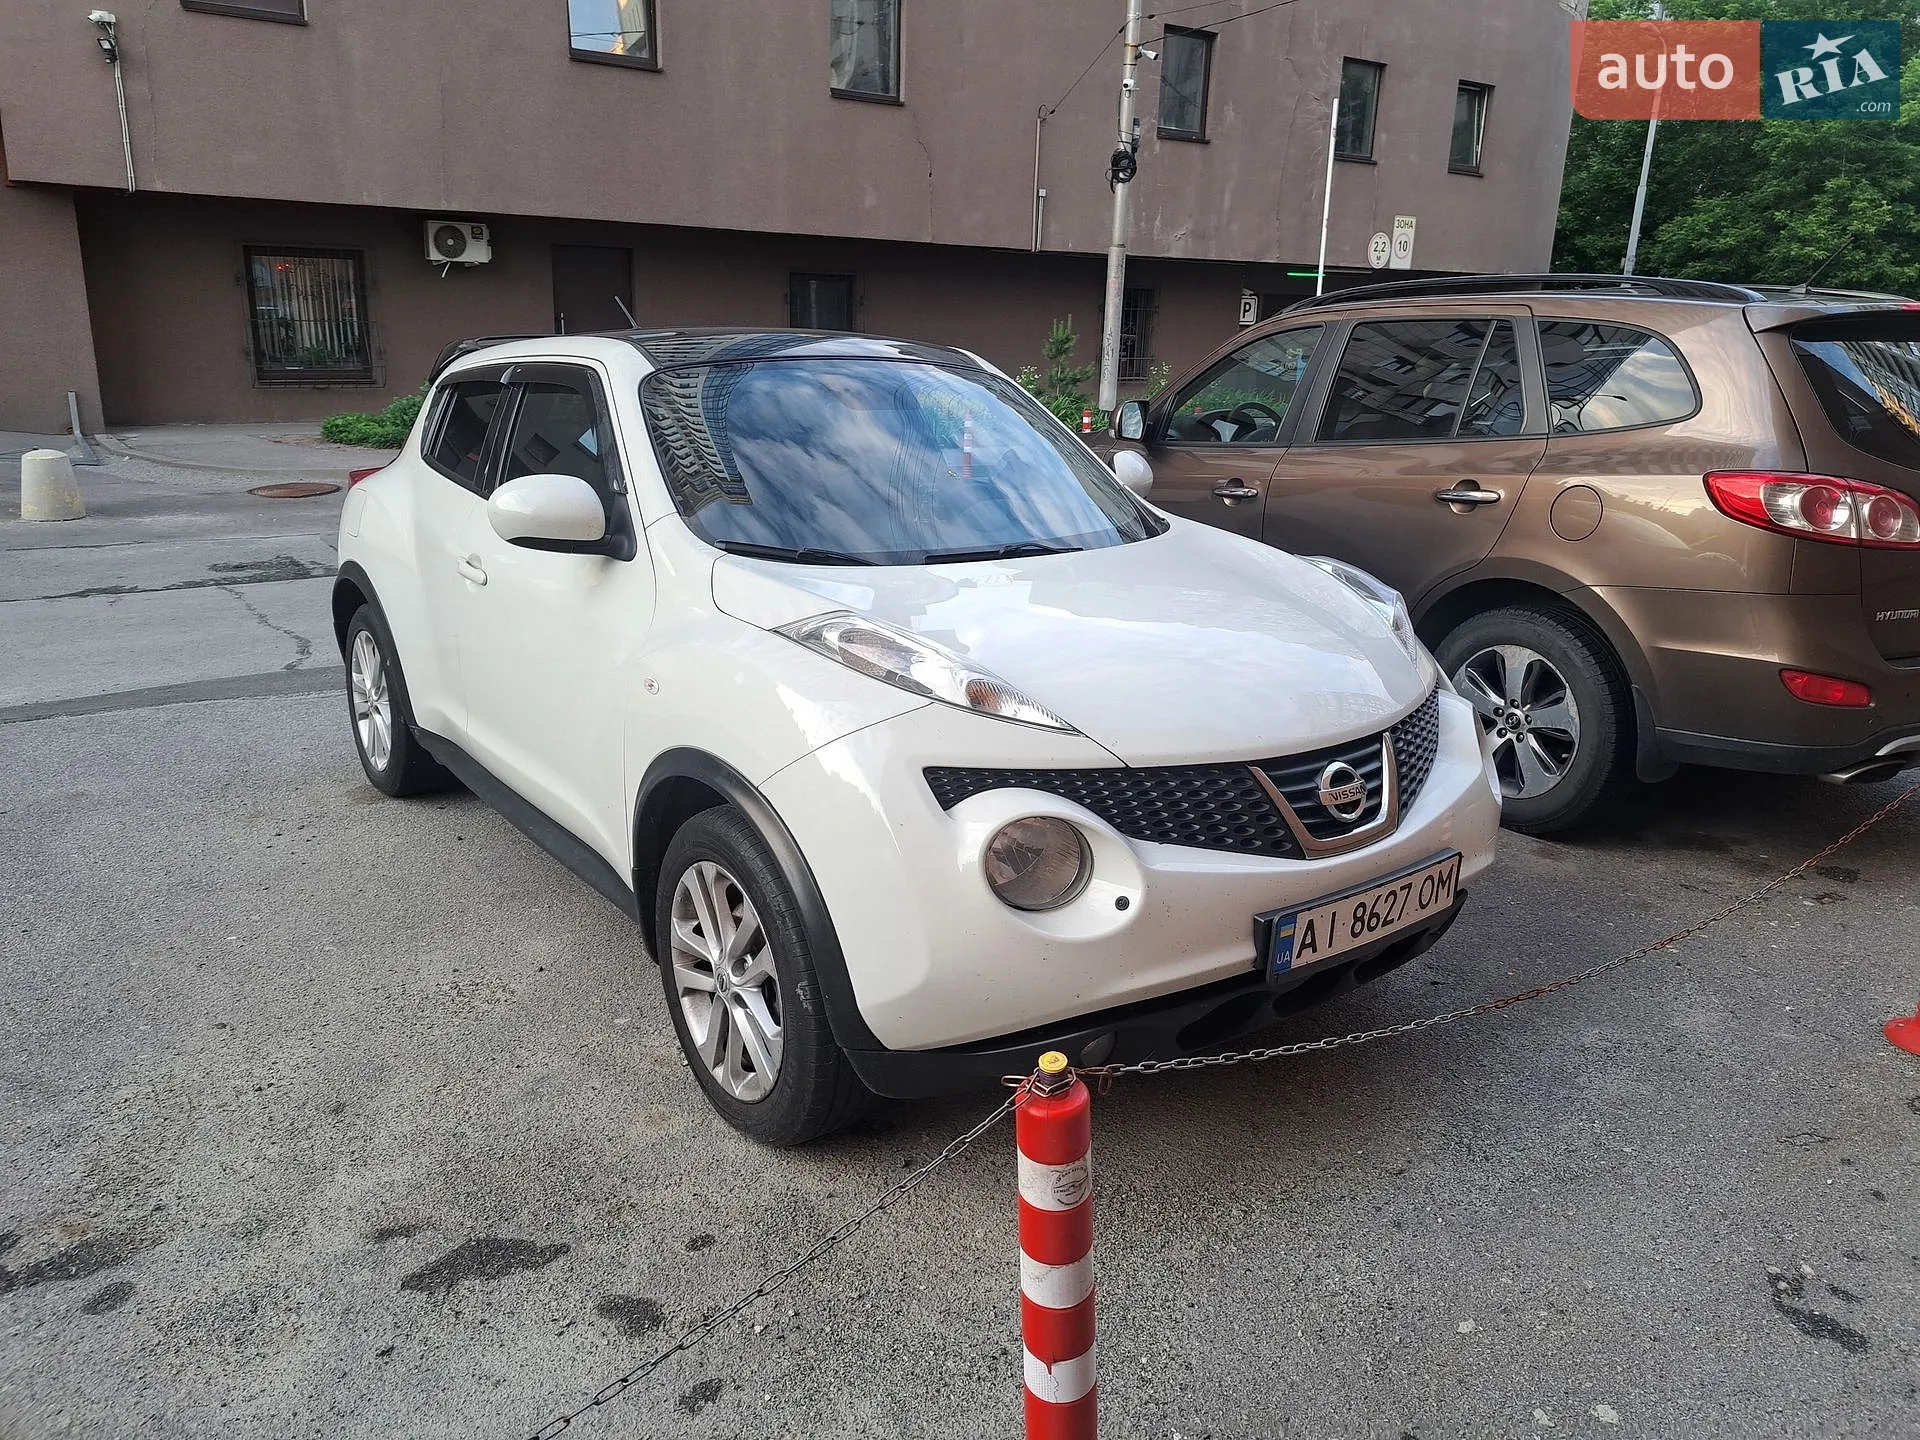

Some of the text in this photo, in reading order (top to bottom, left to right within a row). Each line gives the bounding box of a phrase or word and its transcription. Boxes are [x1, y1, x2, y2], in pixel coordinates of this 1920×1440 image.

[1395, 219, 1414, 230] ЗОНА
[1373, 241, 1387, 253] 2,2
[1398, 240, 1408, 252] 10
[1242, 301, 1252, 319] P
[1330, 785, 1366, 801] NISSAN
[1350, 882, 1413, 939] 8627
[1418, 863, 1455, 910] OM
[1276, 952, 1291, 965] UA
